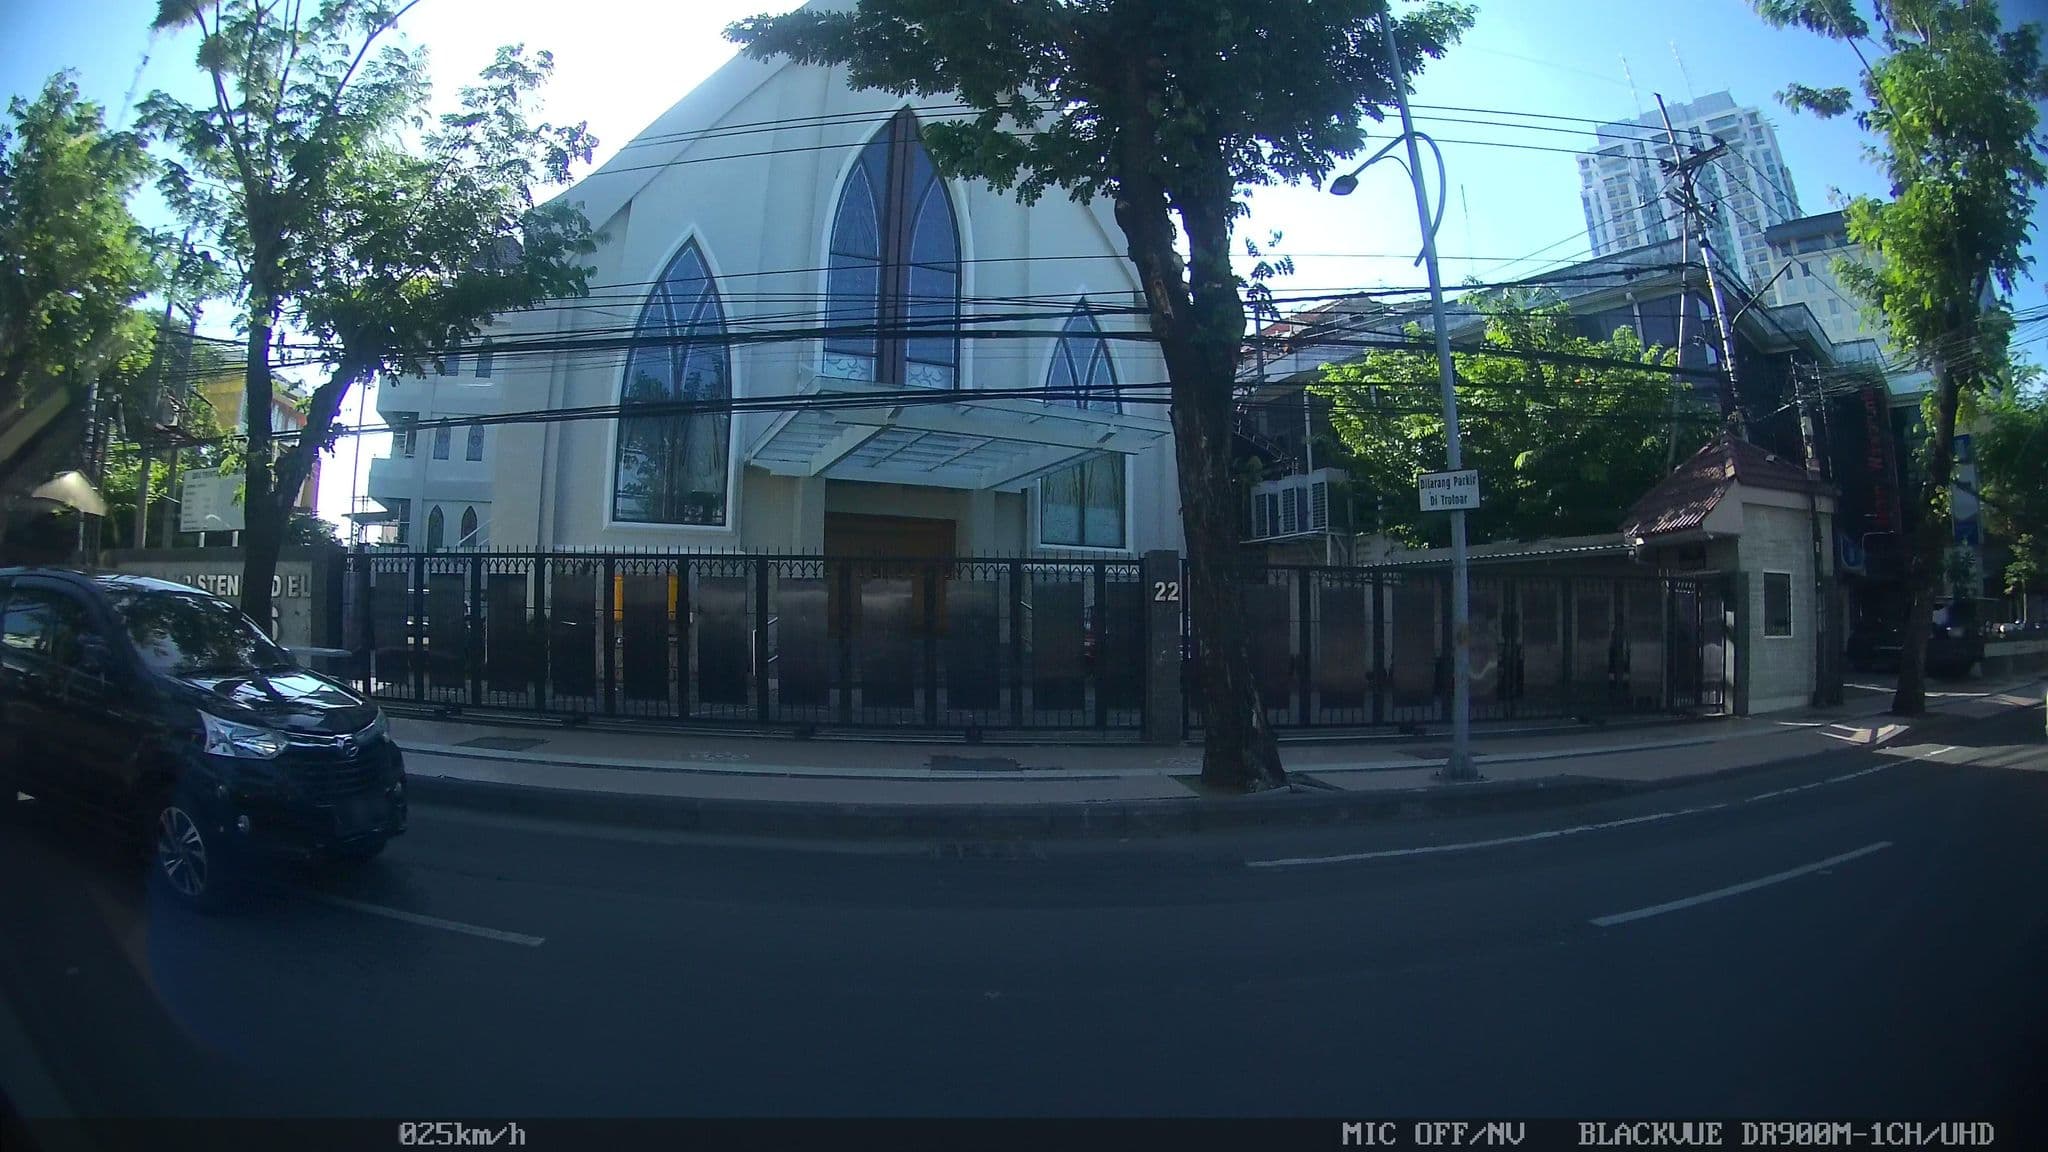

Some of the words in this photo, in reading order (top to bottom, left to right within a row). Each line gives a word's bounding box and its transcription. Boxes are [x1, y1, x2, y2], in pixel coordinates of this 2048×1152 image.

[1420, 479, 1450, 490] Dilarang
[1453, 475, 1477, 487] Parkir
[1430, 495, 1438, 506] Di
[1441, 494, 1468, 505] Trotoar
[1154, 581, 1179, 601] 22
